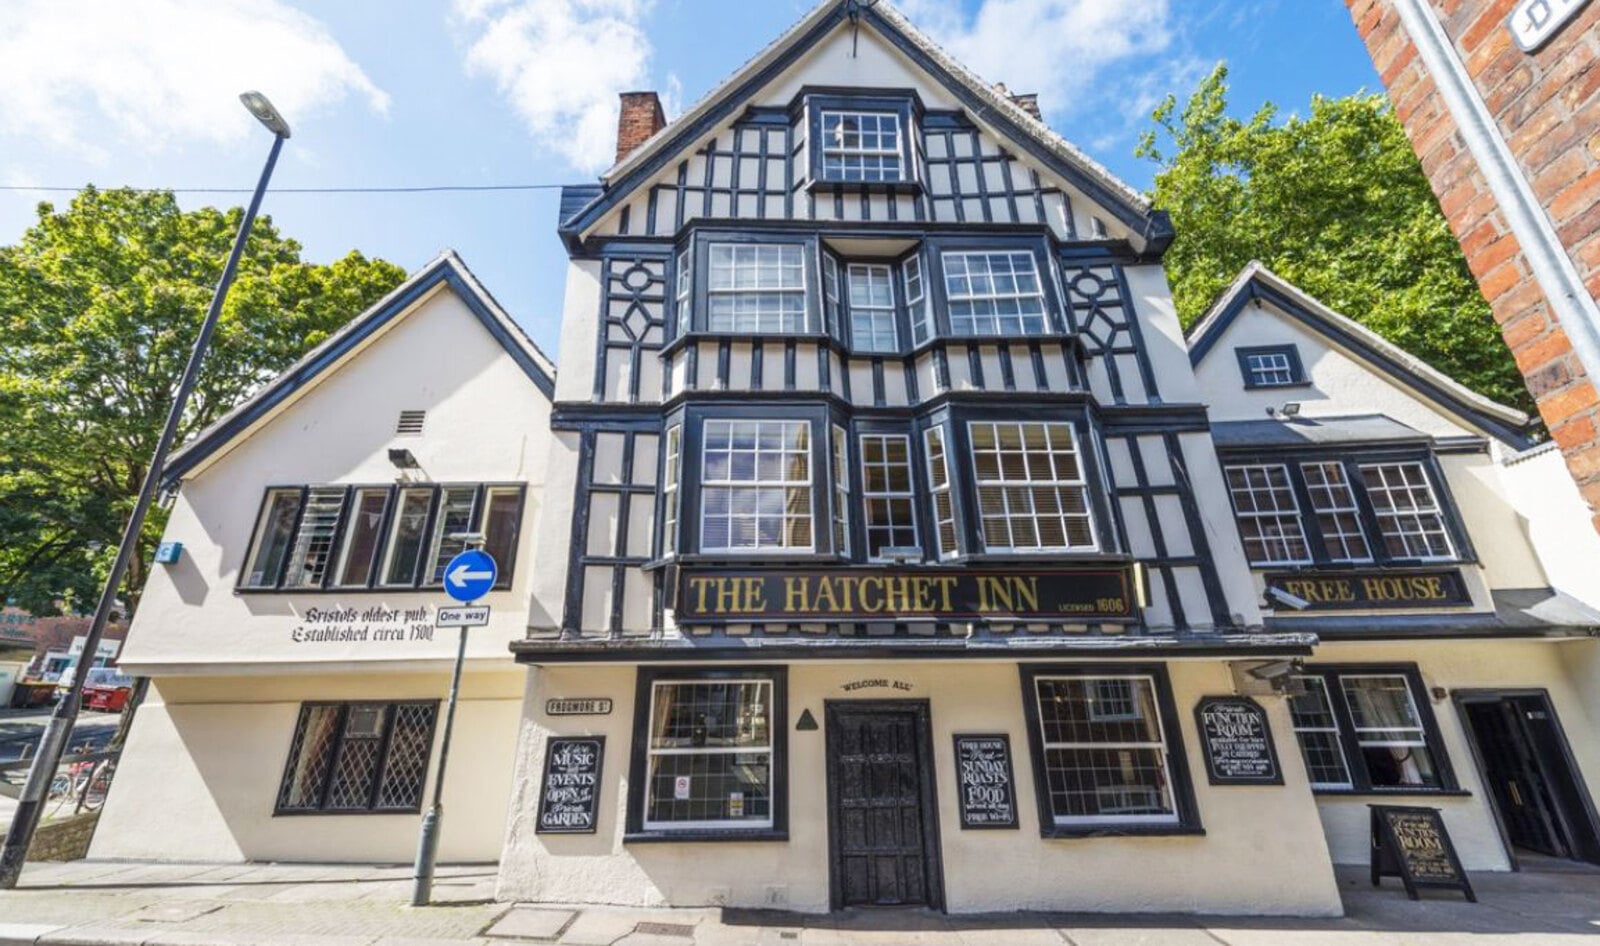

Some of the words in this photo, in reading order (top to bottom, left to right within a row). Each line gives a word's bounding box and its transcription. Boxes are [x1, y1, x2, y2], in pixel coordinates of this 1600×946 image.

[690, 577, 767, 613] THE
[784, 576, 957, 612] HATCHET
[976, 576, 1039, 612] INN
[1286, 580, 1354, 601] FREE
[1362, 577, 1446, 599] HOUSE
[1097, 598, 1124, 612] 1606
[361, 606, 399, 622] oldest
[440, 611, 461, 621] One
[465, 608, 486, 620] way
[291, 626, 369, 642] Established
[373, 629, 404, 641] circa
[1203, 712, 1260, 725] FUNCTION
[1215, 722, 1254, 737] ROOM
[552, 753, 595, 765] MUSIC
[962, 760, 1006, 773] SUNDAY
[548, 773, 596, 785] EVENTS
[963, 772, 1008, 785] ROASTS
[968, 786, 1005, 804] FOOD
[543, 812, 592, 826] GARDEN
